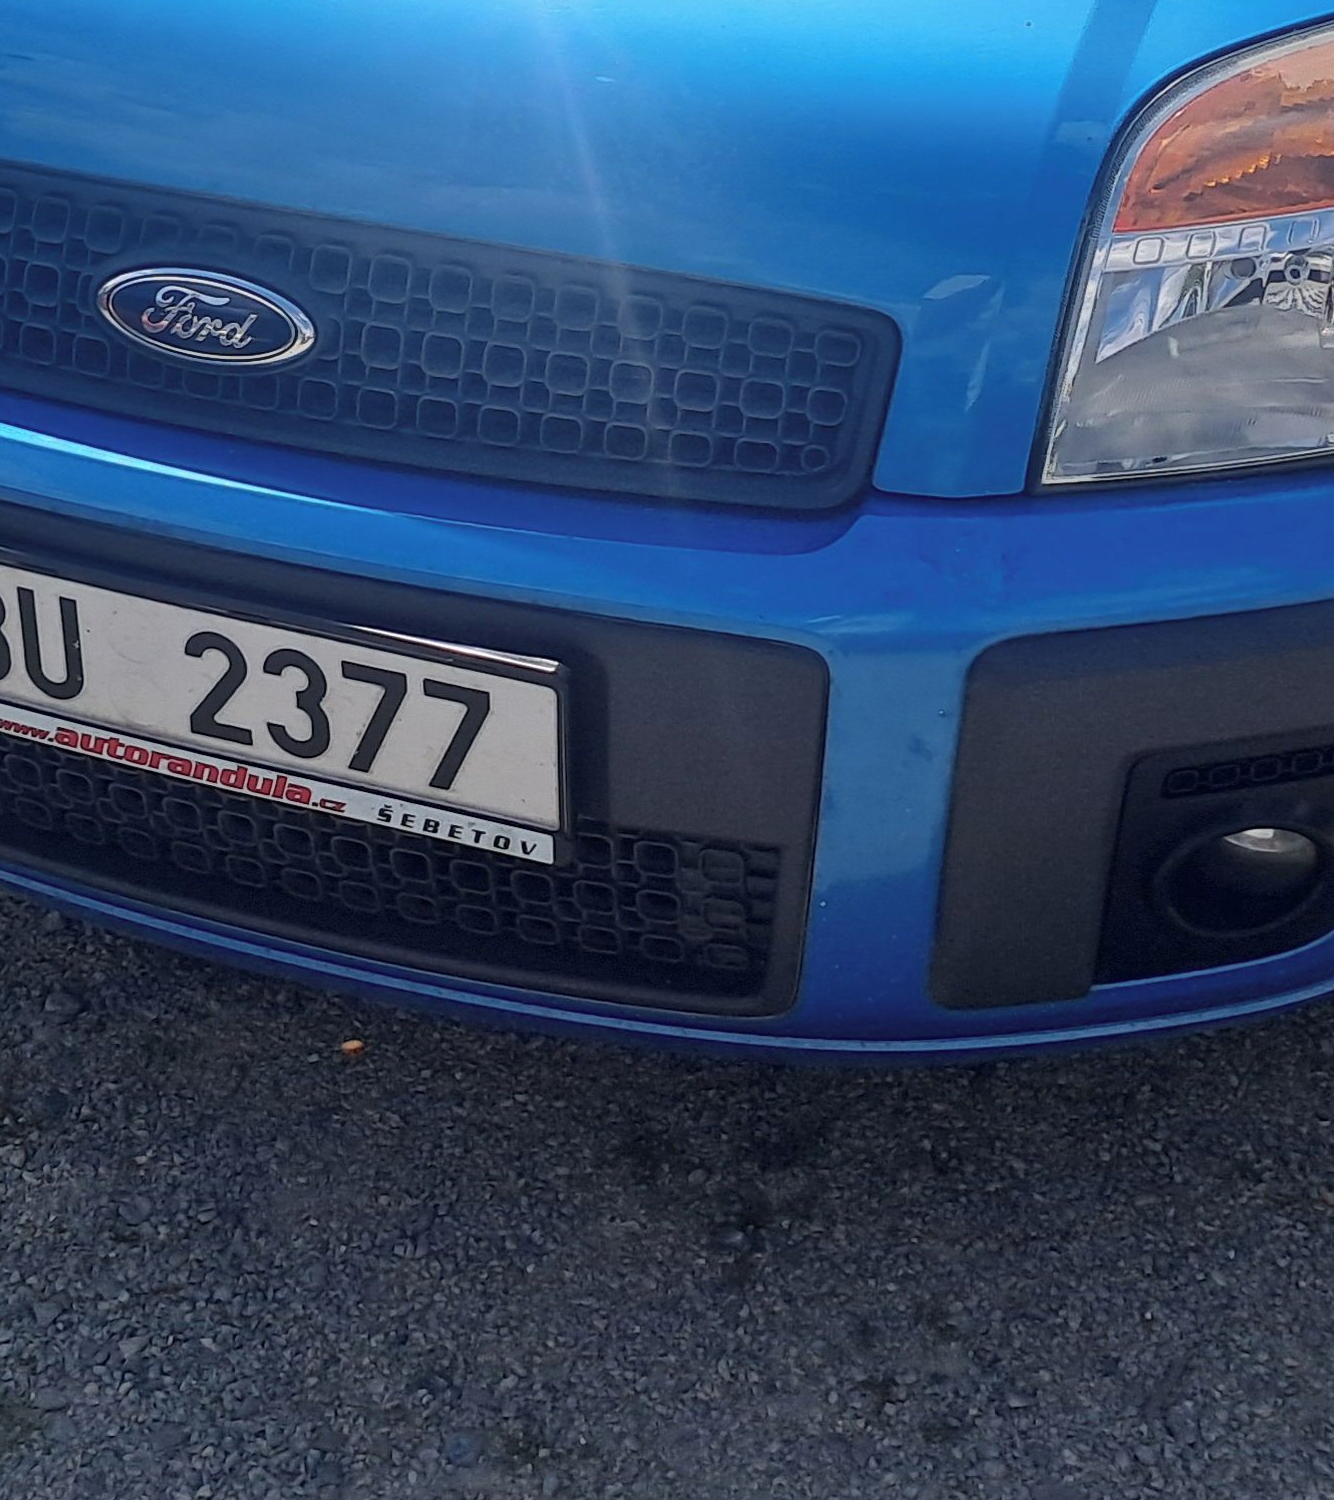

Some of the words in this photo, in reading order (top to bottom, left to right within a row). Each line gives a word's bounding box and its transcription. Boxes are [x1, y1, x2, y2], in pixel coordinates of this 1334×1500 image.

[141, 285, 258, 349] Ford
[184, 631, 491, 789] 2377
[376, 803, 539, 857] ŠEBETOV
